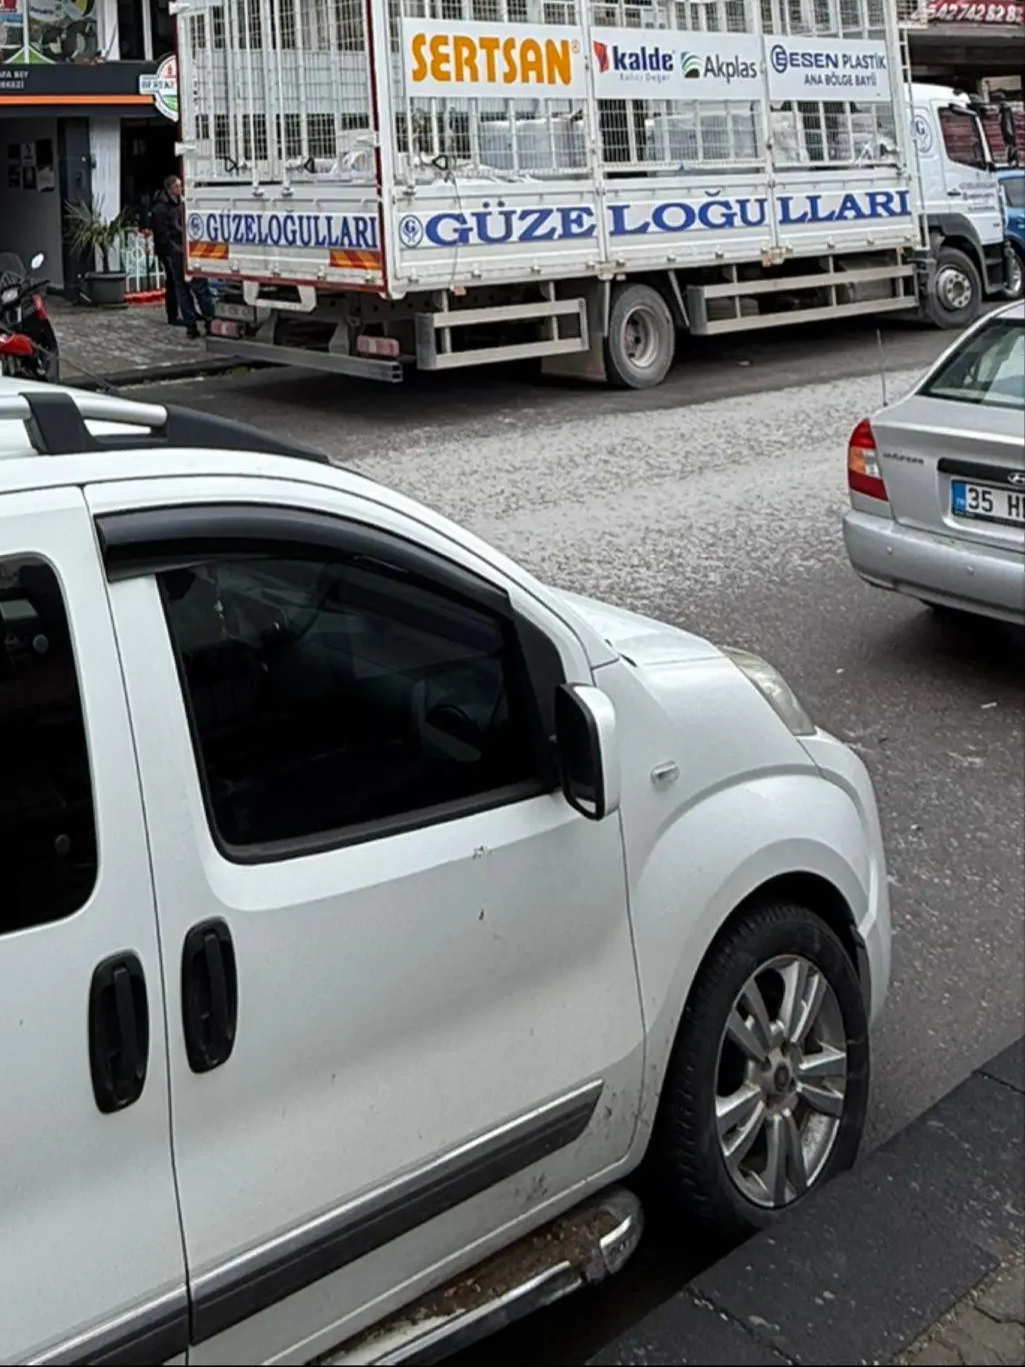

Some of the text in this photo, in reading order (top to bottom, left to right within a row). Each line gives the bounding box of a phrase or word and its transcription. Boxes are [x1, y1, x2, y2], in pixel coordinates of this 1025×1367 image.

[411, 33, 573, 86] SERTSAN
[613, 45, 674, 72] kalde
[704, 53, 757, 83] Akplas
[789, 52, 838, 69] ESEN
[804, 73, 822, 86] ANA
[825, 72, 853, 87] BÖLGE
[968, 487, 1025, 518] 35 H
